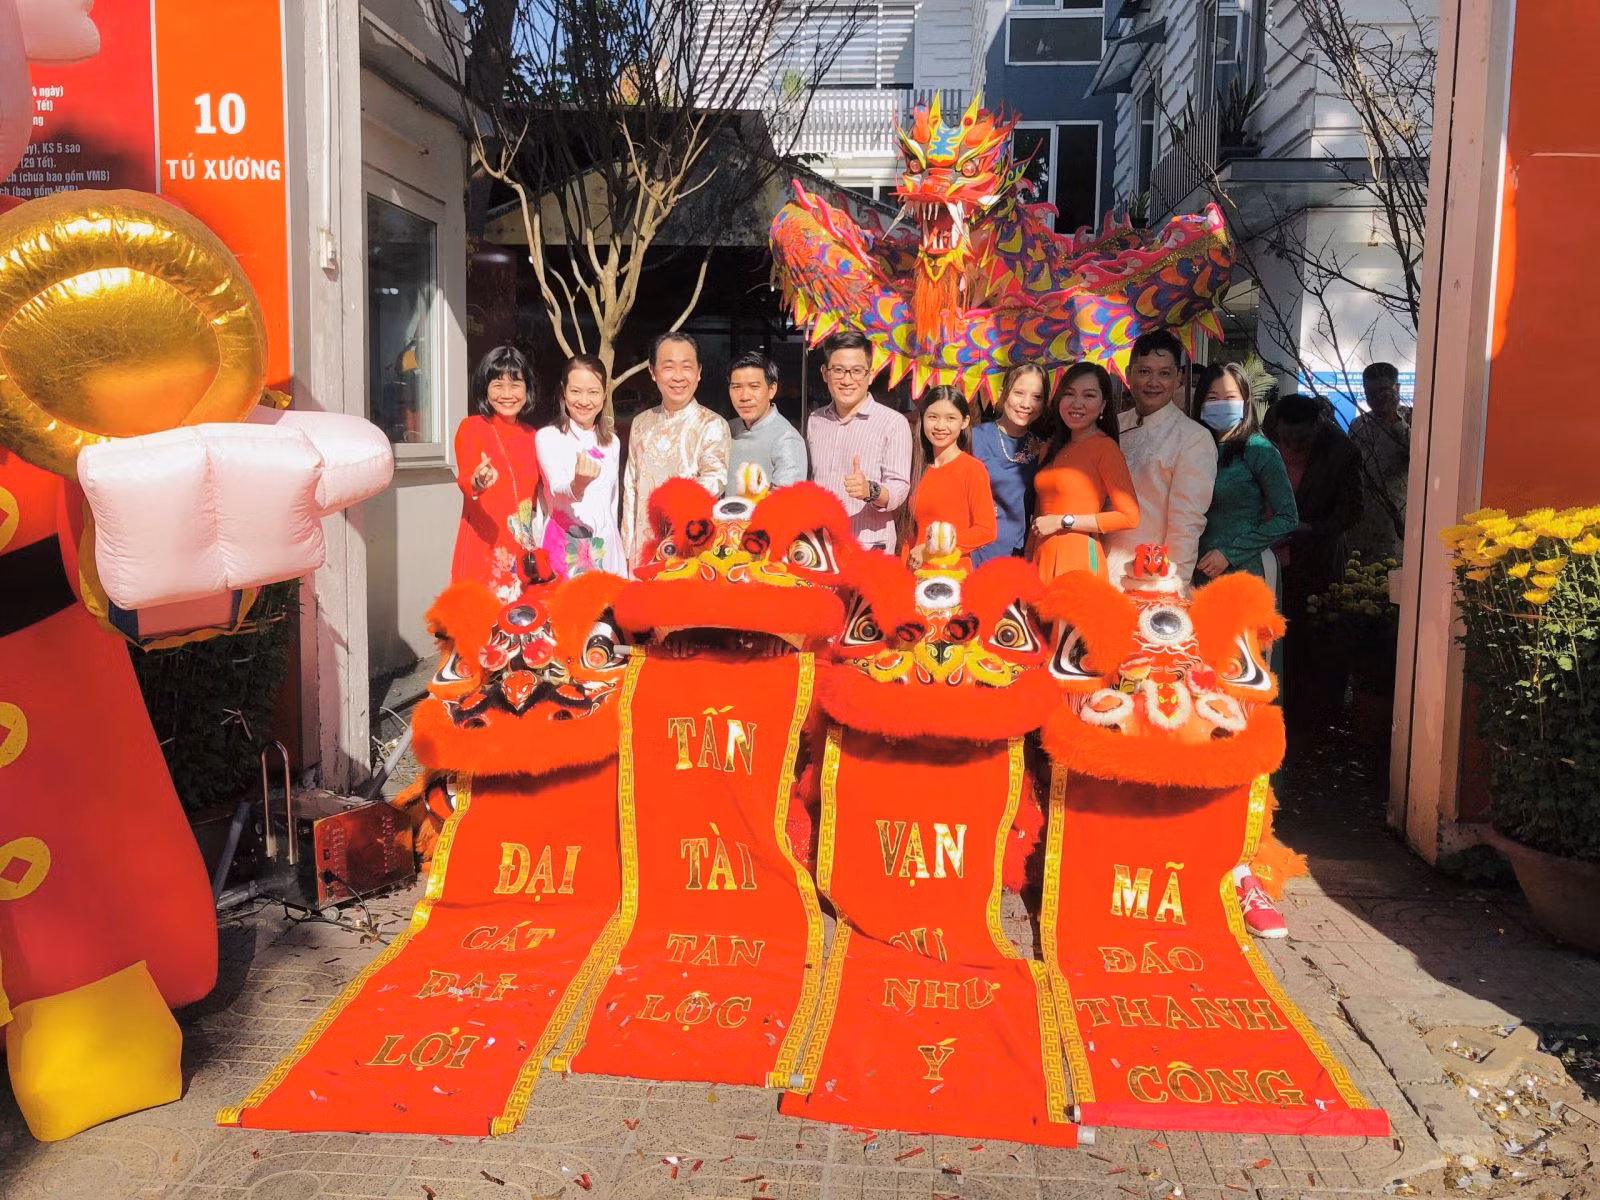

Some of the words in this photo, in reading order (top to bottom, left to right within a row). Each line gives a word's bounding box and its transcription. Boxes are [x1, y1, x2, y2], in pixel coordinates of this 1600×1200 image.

[36, 98, 54, 112] Tết)
[39, 85, 64, 98] ngày)
[32, 116, 44, 126] ng
[194, 93, 246, 135] 10
[21, 157, 35, 168] (29
[43, 143, 55, 154] KS
[57, 143, 63, 154] 5
[65, 143, 81, 154] sao
[20, 172, 44, 183] (chưa
[46, 171, 63, 182] bao
[86, 170, 110, 182] VMB)
[166, 153, 196, 181] TÚ
[203, 155, 281, 181] XƯƠNG
[12, 186, 31, 197] (bao
[668, 706, 757, 775] TẤN
[681, 822, 757, 890] TÀI
[876, 820, 967, 887] VẠN
[494, 842, 581, 902] ĐẠI
[1111, 862, 1187, 926] MÃ
[461, 921, 556, 952] CÁT
[1098, 942, 1204, 974] ĐÁO
[637, 990, 752, 1032] LỘC
[883, 977, 1001, 1011] NHƯ
[366, 1026, 481, 1072] LỢI
[918, 1037, 958, 1081] Ý
[1127, 1061, 1307, 1106] CÔNG
